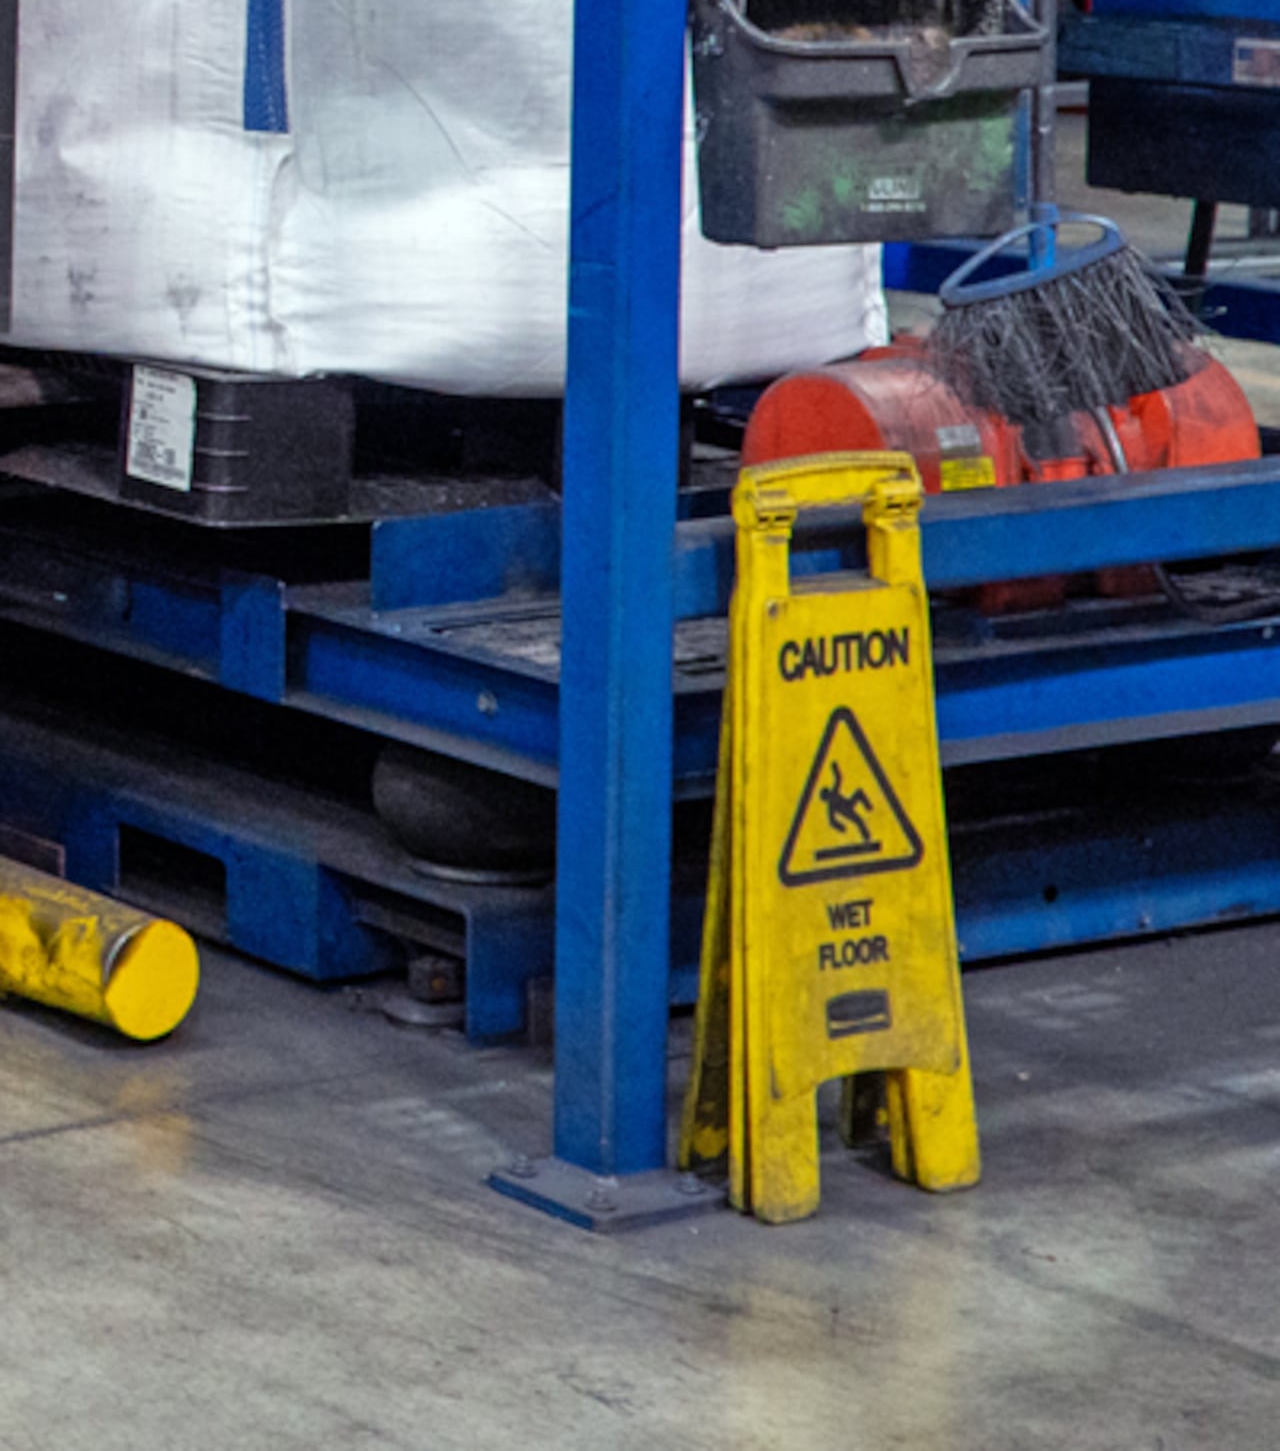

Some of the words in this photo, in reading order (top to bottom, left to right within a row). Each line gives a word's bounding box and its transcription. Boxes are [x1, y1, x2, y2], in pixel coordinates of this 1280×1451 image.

[779, 626, 909, 682] CAUTION
[827, 897, 874, 930] WET
[819, 935, 890, 971] FLOOR
